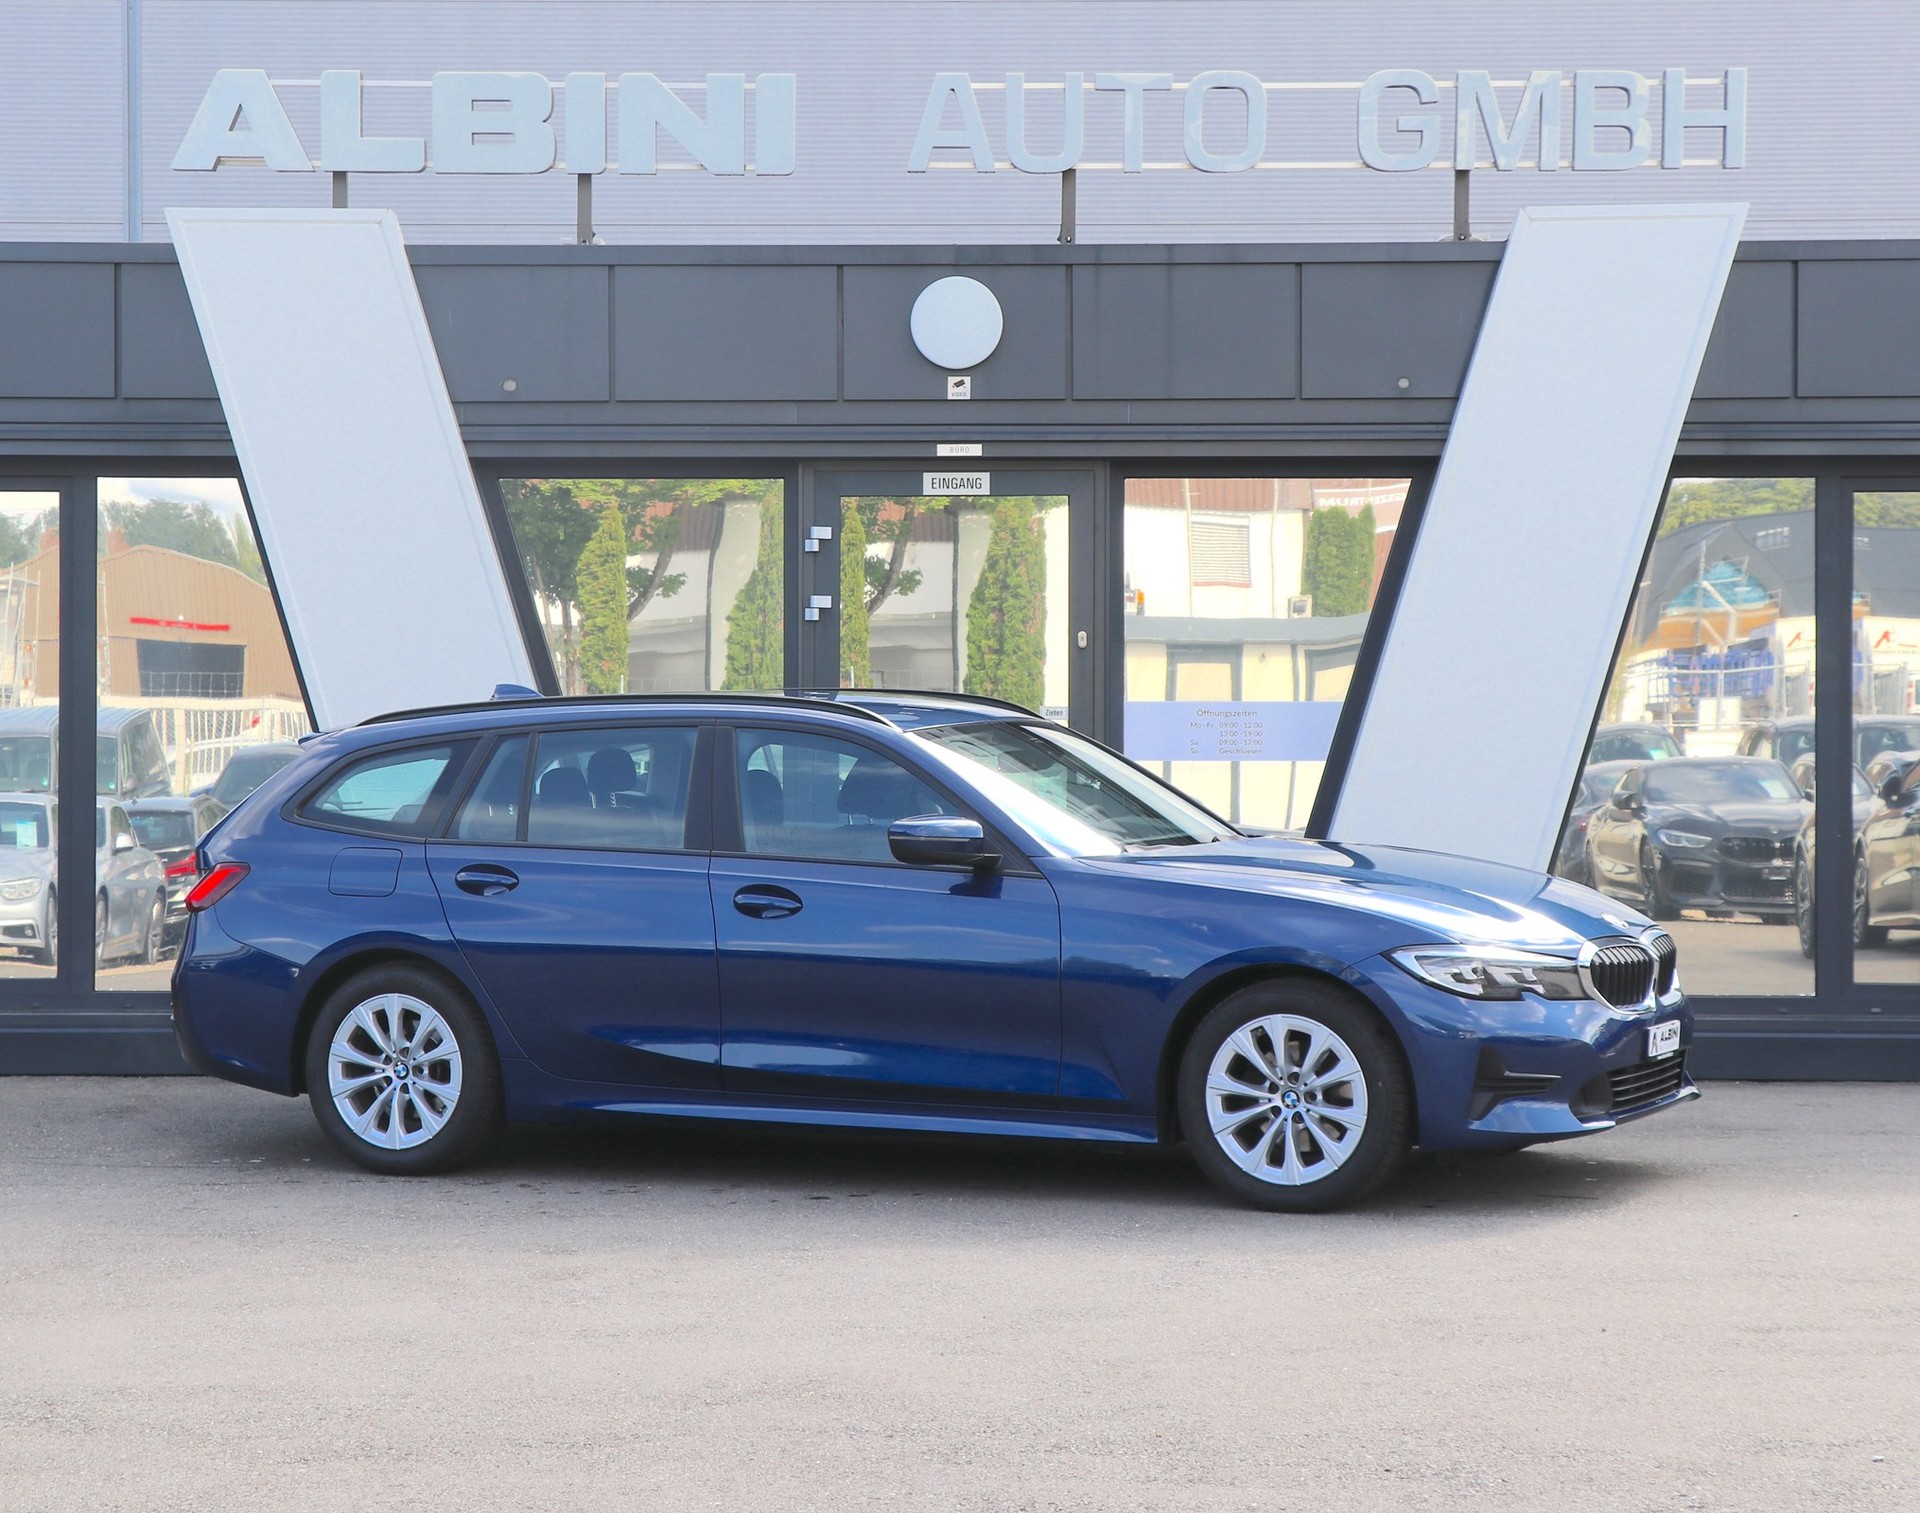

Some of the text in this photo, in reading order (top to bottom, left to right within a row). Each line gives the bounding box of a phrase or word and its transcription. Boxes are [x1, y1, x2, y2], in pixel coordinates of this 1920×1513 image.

[171, 67, 1748, 176] ALBINI AUTO GMBH
[931, 477, 983, 490] EINGANG
[1218, 747, 1263, 755] Geschlossen
